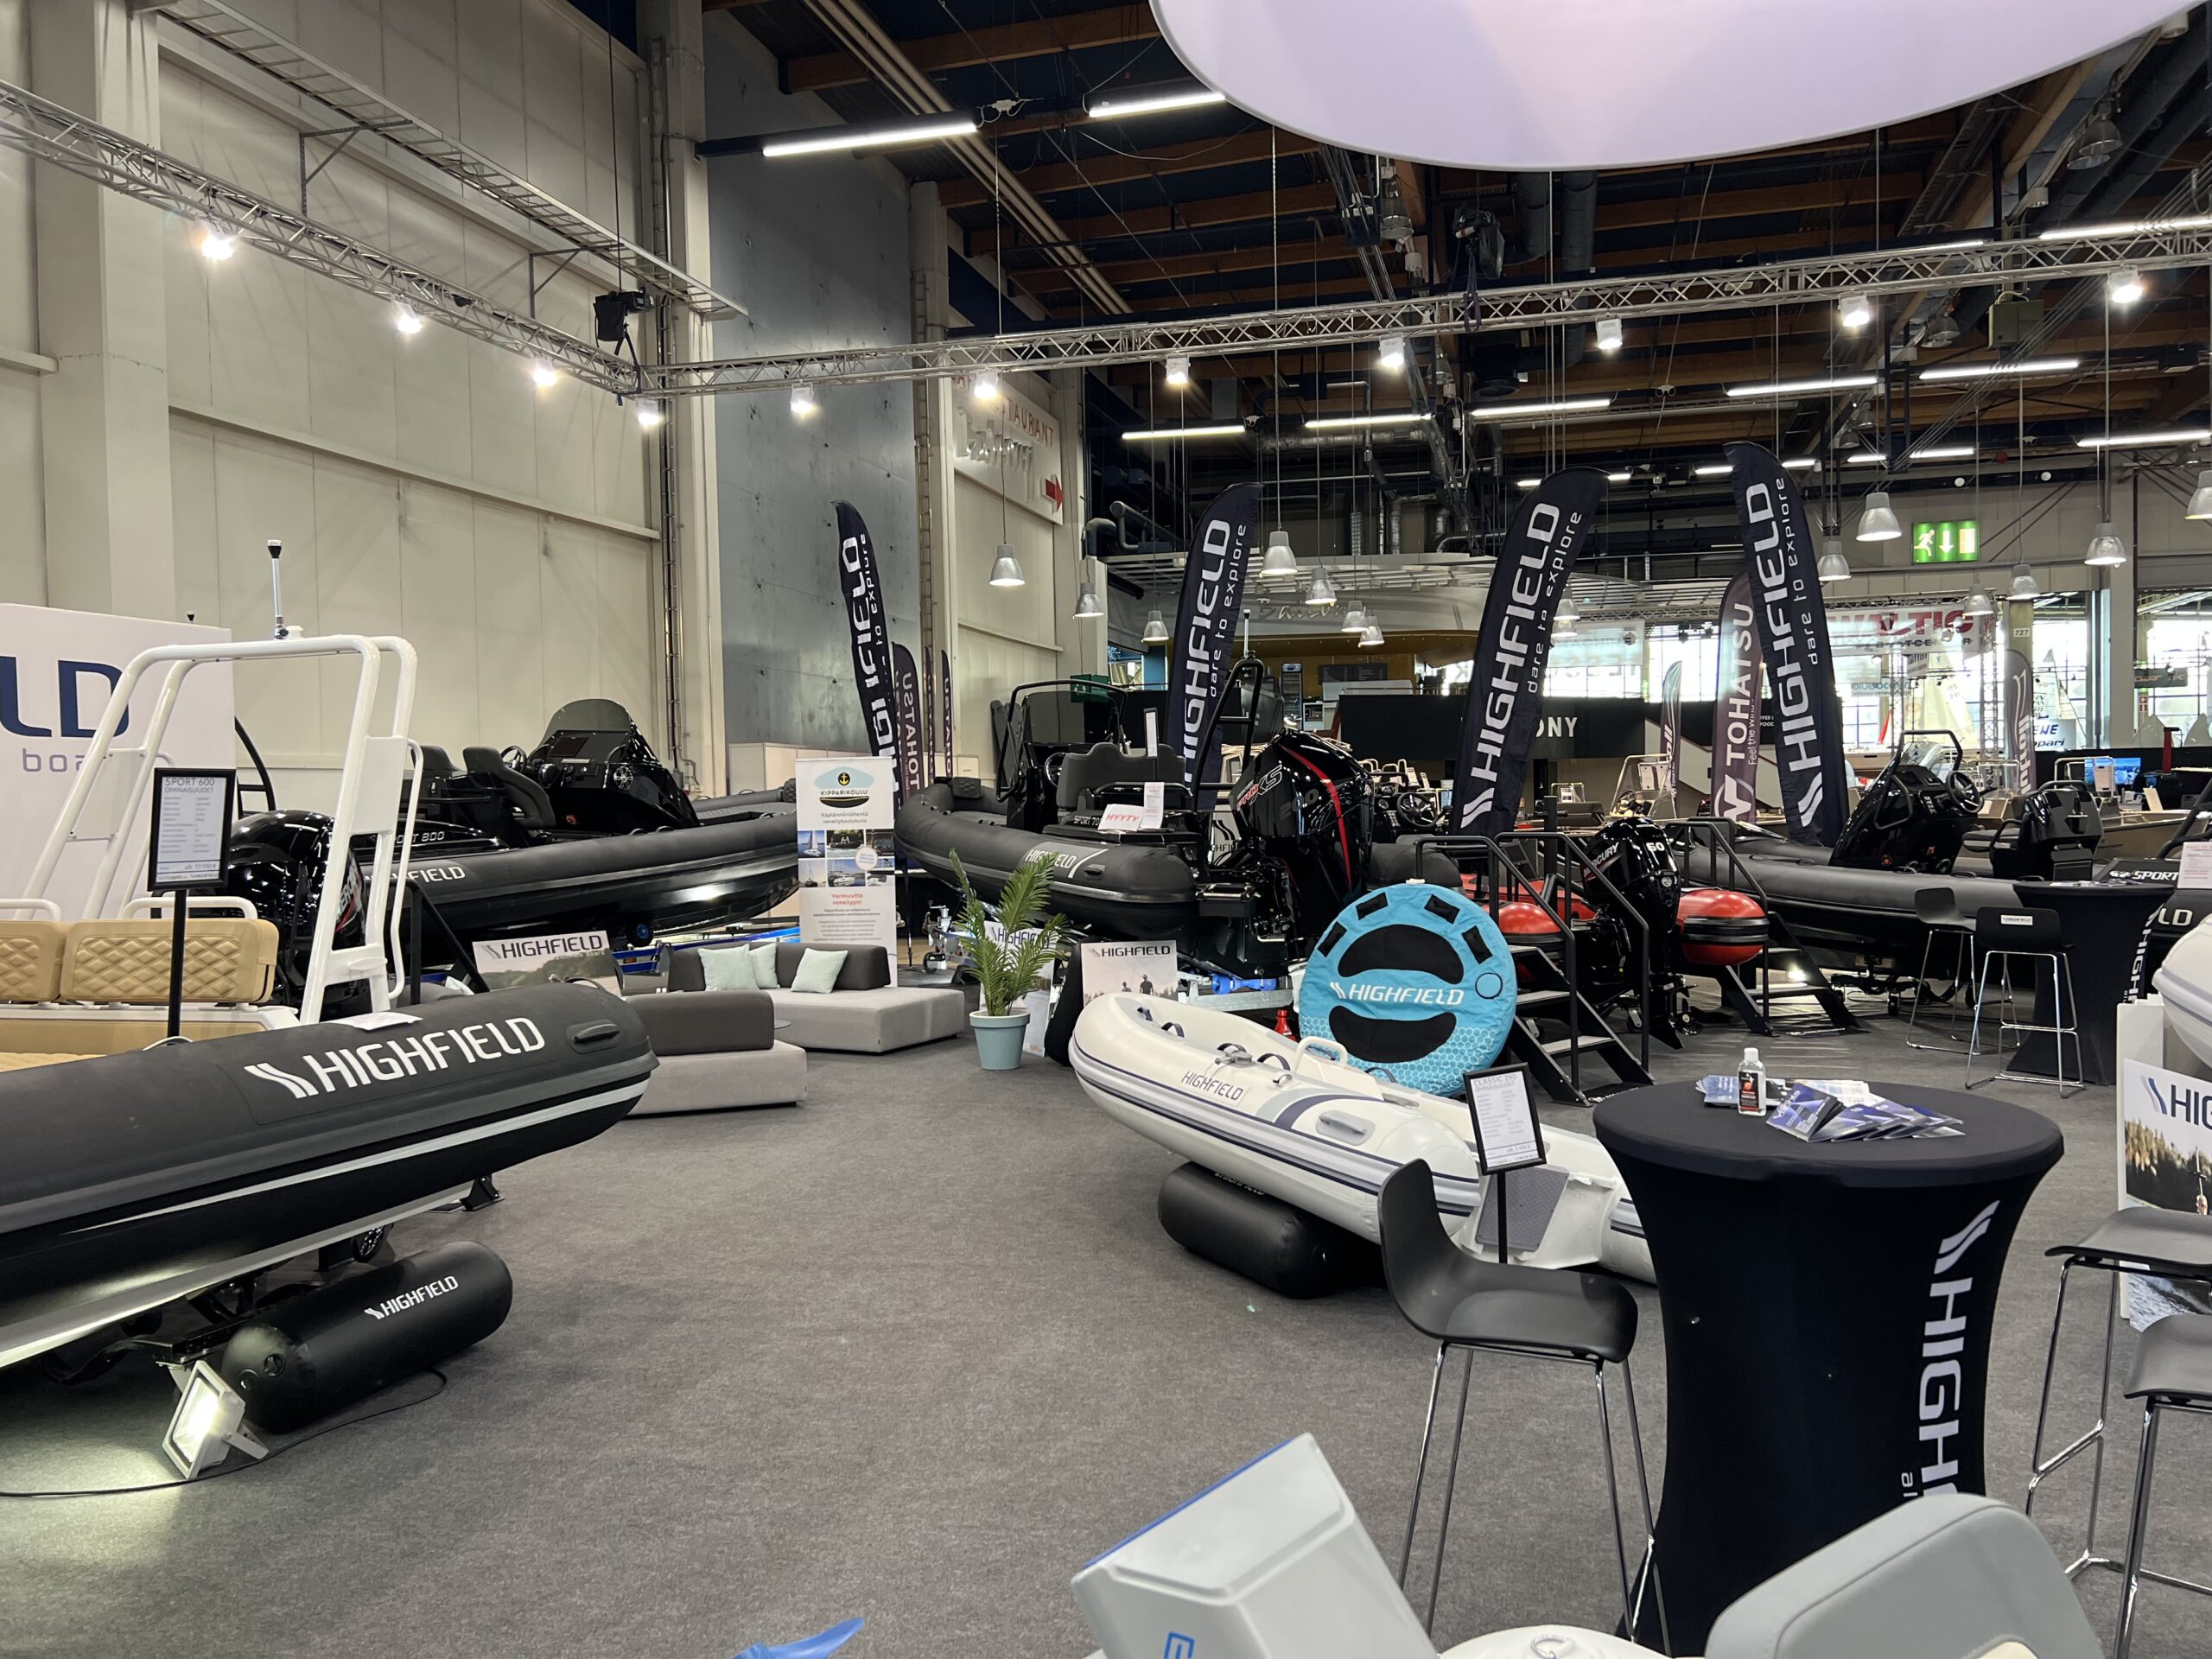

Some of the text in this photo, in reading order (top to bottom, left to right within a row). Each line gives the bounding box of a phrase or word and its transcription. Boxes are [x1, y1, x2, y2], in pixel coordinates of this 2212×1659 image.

[1775, 477, 1818, 665] dare to explore
[1211, 524, 1247, 697] dare to explore
[1528, 512, 1582, 694] dare to explore
[1471, 503, 1560, 782] HIGHFIELD
[1746, 482, 1821, 772] HIGHFIELD
[1726, 602, 1754, 766] TOHATSU
[1747, 730, 1757, 745] the
[22, 748, 86, 772] boa
[1747, 747, 1758, 765] Feel
[165, 778, 214, 786] SPORT 600
[1249, 764, 1282, 806] XS
[1106, 814, 1141, 823] MYYTY
[421, 831, 445, 842] 800
[1025, 849, 1077, 868] HIGELD
[1583, 842, 1619, 879] MRCURY
[2132, 870, 2180, 880] SPORT
[501, 935, 603, 958] HIGHFIELD
[1102, 946, 1170, 957] HIGHFIELD
[2127, 928, 2152, 1004] HIGH
[1349, 983, 1465, 1006] HIGHFIELD
[303, 1017, 545, 1093] HIGHFIELD
[1180, 1071, 1244, 1102] HIGHFIELD
[1473, 1076, 1503, 1087] CLASSIC
[380, 1275, 460, 1316] HIGHFIELD
[1918, 1276, 1974, 1497] HIGH
